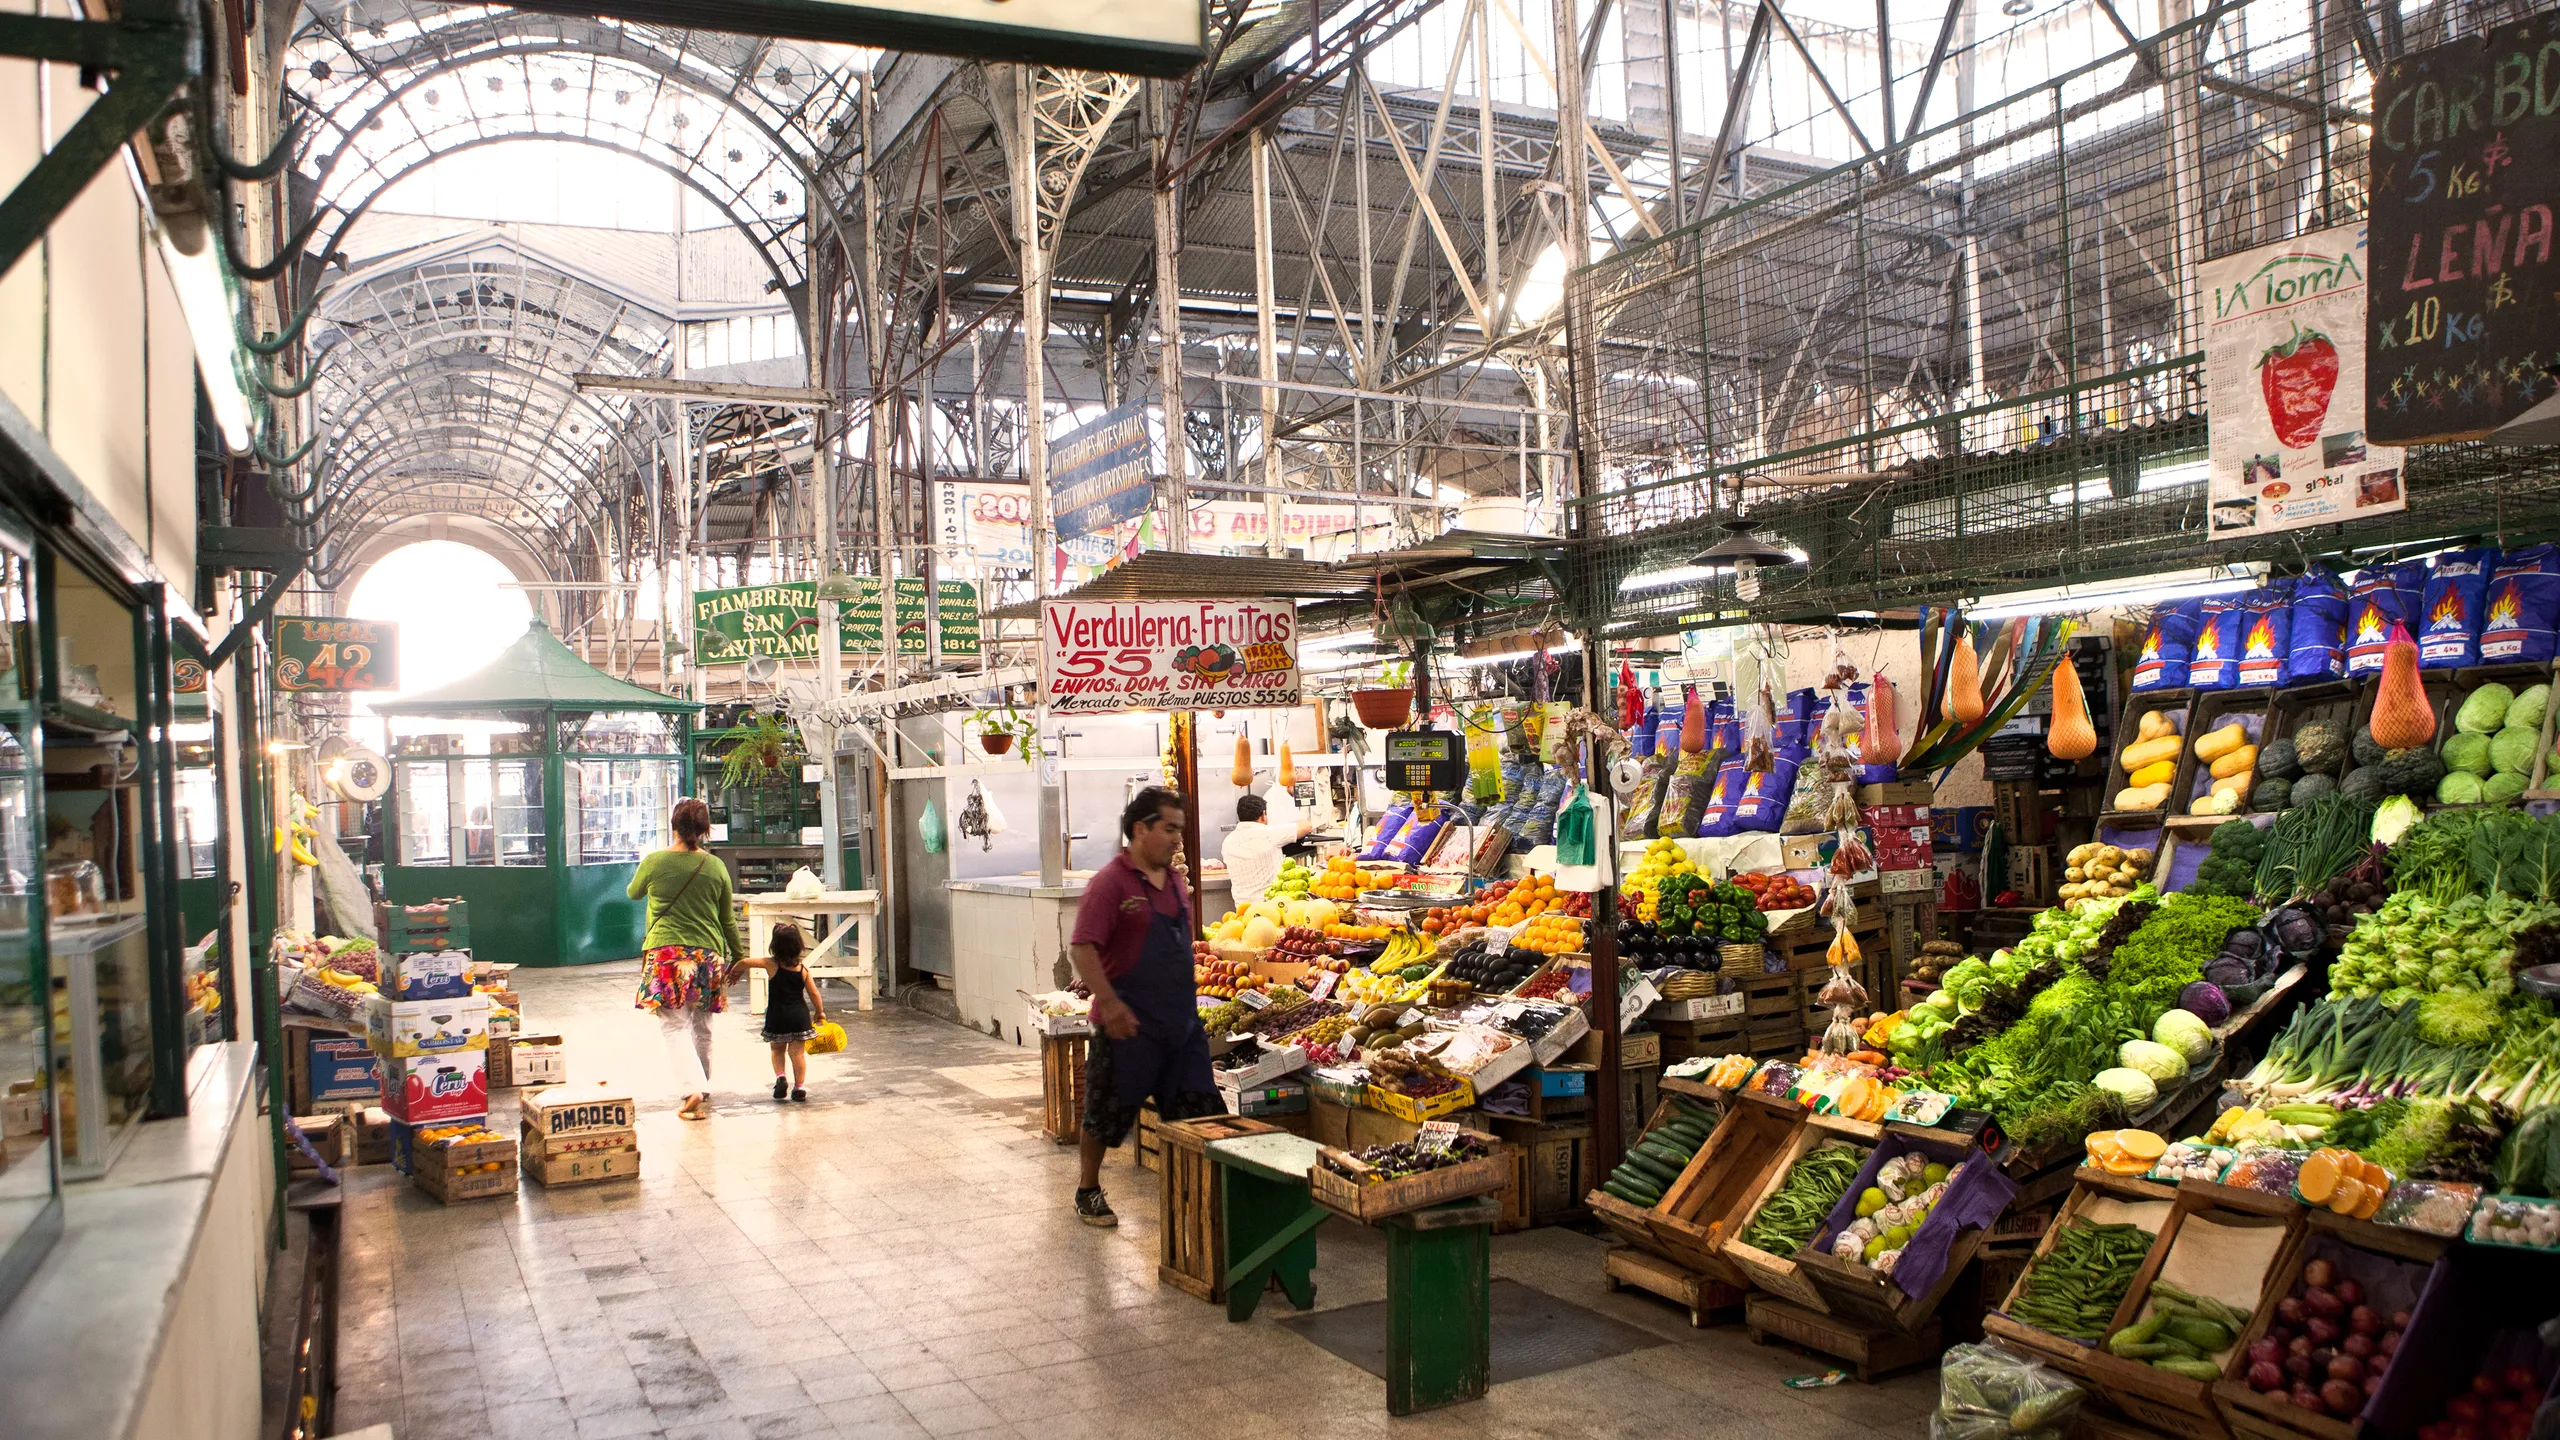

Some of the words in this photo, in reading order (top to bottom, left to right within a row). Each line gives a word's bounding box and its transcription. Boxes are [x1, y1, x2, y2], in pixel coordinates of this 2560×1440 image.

[2404, 150, 2442, 204] 5
[2401, 203, 2554, 292] LEÑA
[2211, 311, 2273, 334] FRUTILLAS
[2283, 289, 2367, 317] ARGENTINAS
[2404, 296, 2441, 347] 10
[302, 621, 378, 643] LOCAL
[742, 612, 785, 634] SAN
[1244, 644, 1287, 661] FRESH
[1250, 656, 1289, 671] FRUIT
[306, 643, 375, 689] 42
[1051, 677, 1115, 695] ENVIOS
[1123, 675, 1170, 693] DOM.
[1177, 674, 1217, 691] SIN
[1226, 671, 1288, 690] CARGO
[1051, 694, 1122, 710] Mercado
[1192, 690, 1251, 705] PUESTOS
[422, 971, 451, 988] Cervi
[431, 1072, 468, 1098] Cervi
[551, 1105, 626, 1134] AMADEO
